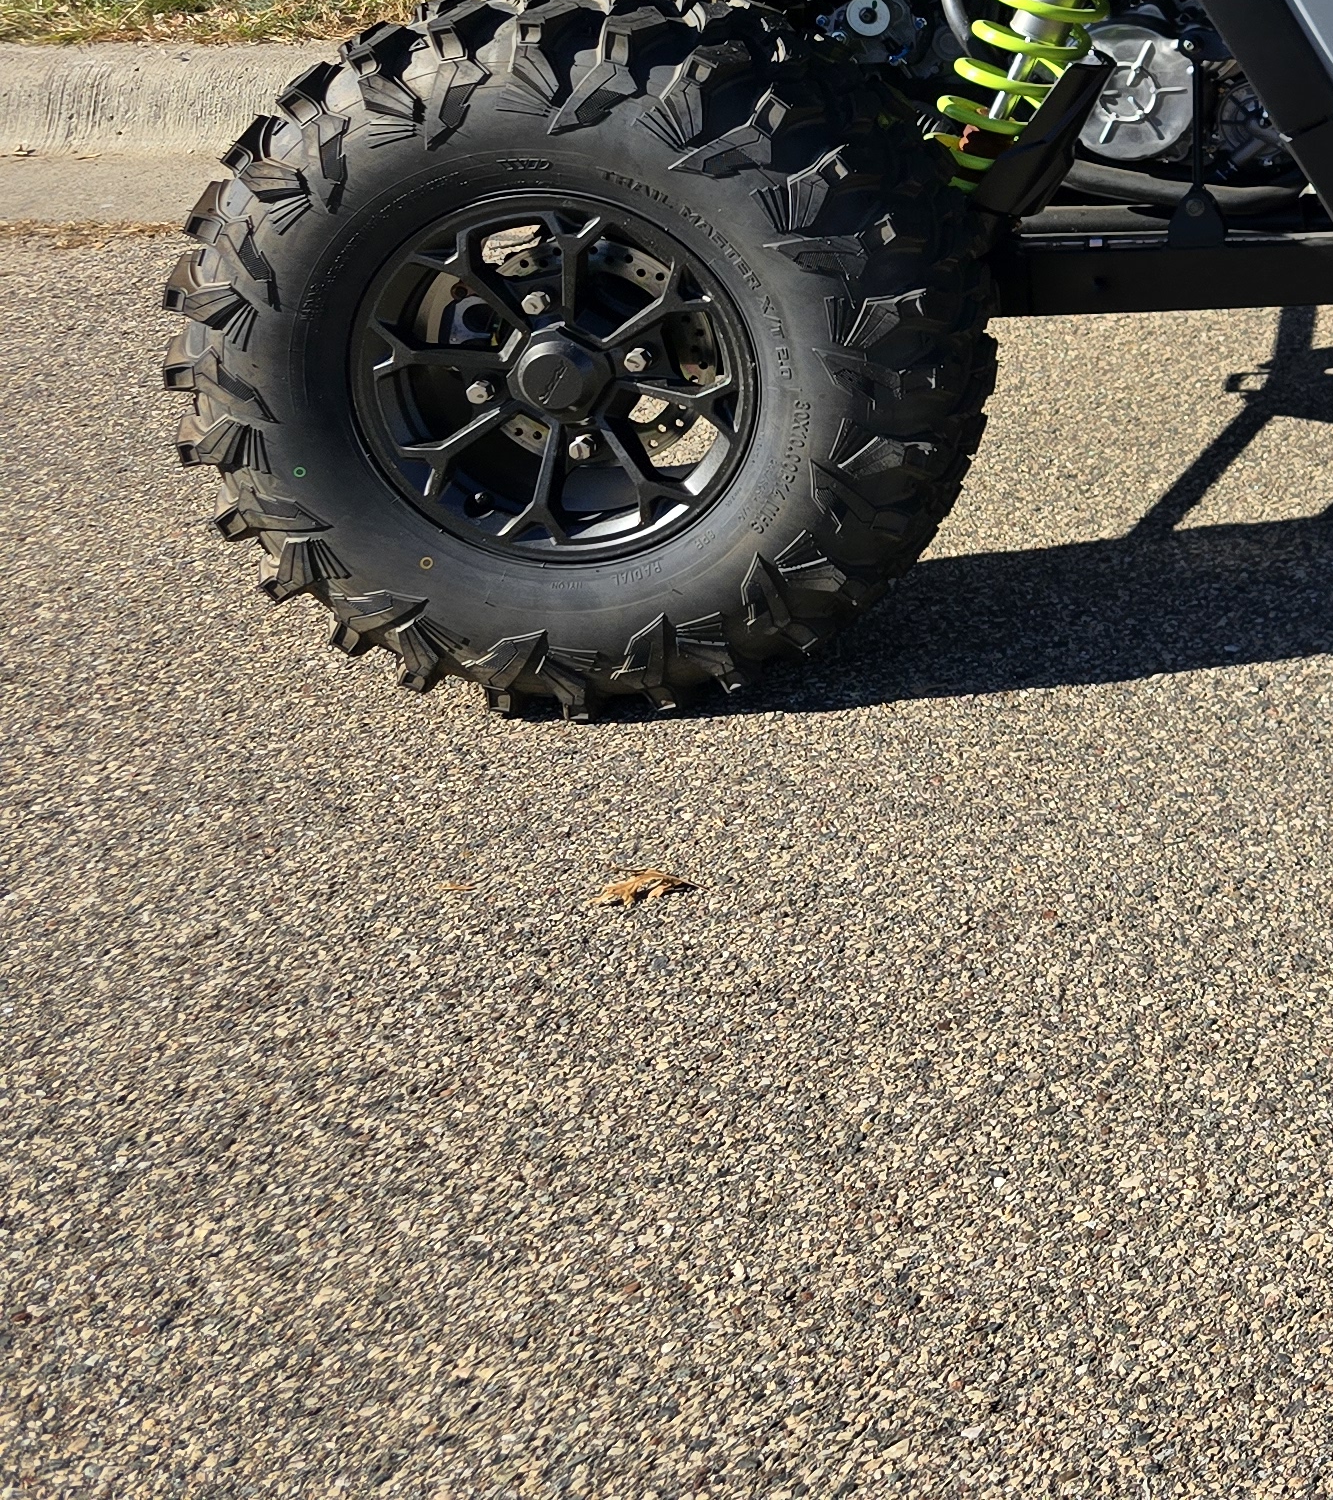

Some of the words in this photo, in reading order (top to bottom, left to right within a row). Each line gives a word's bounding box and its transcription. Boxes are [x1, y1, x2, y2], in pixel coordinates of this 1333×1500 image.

[602, 169, 674, 209] TRAIL
[677, 203, 762, 291] MASTER
[760, 295, 786, 340] X/T
[775, 346, 793, 381] 2.0
[612, 560, 663, 586] RADIAL
